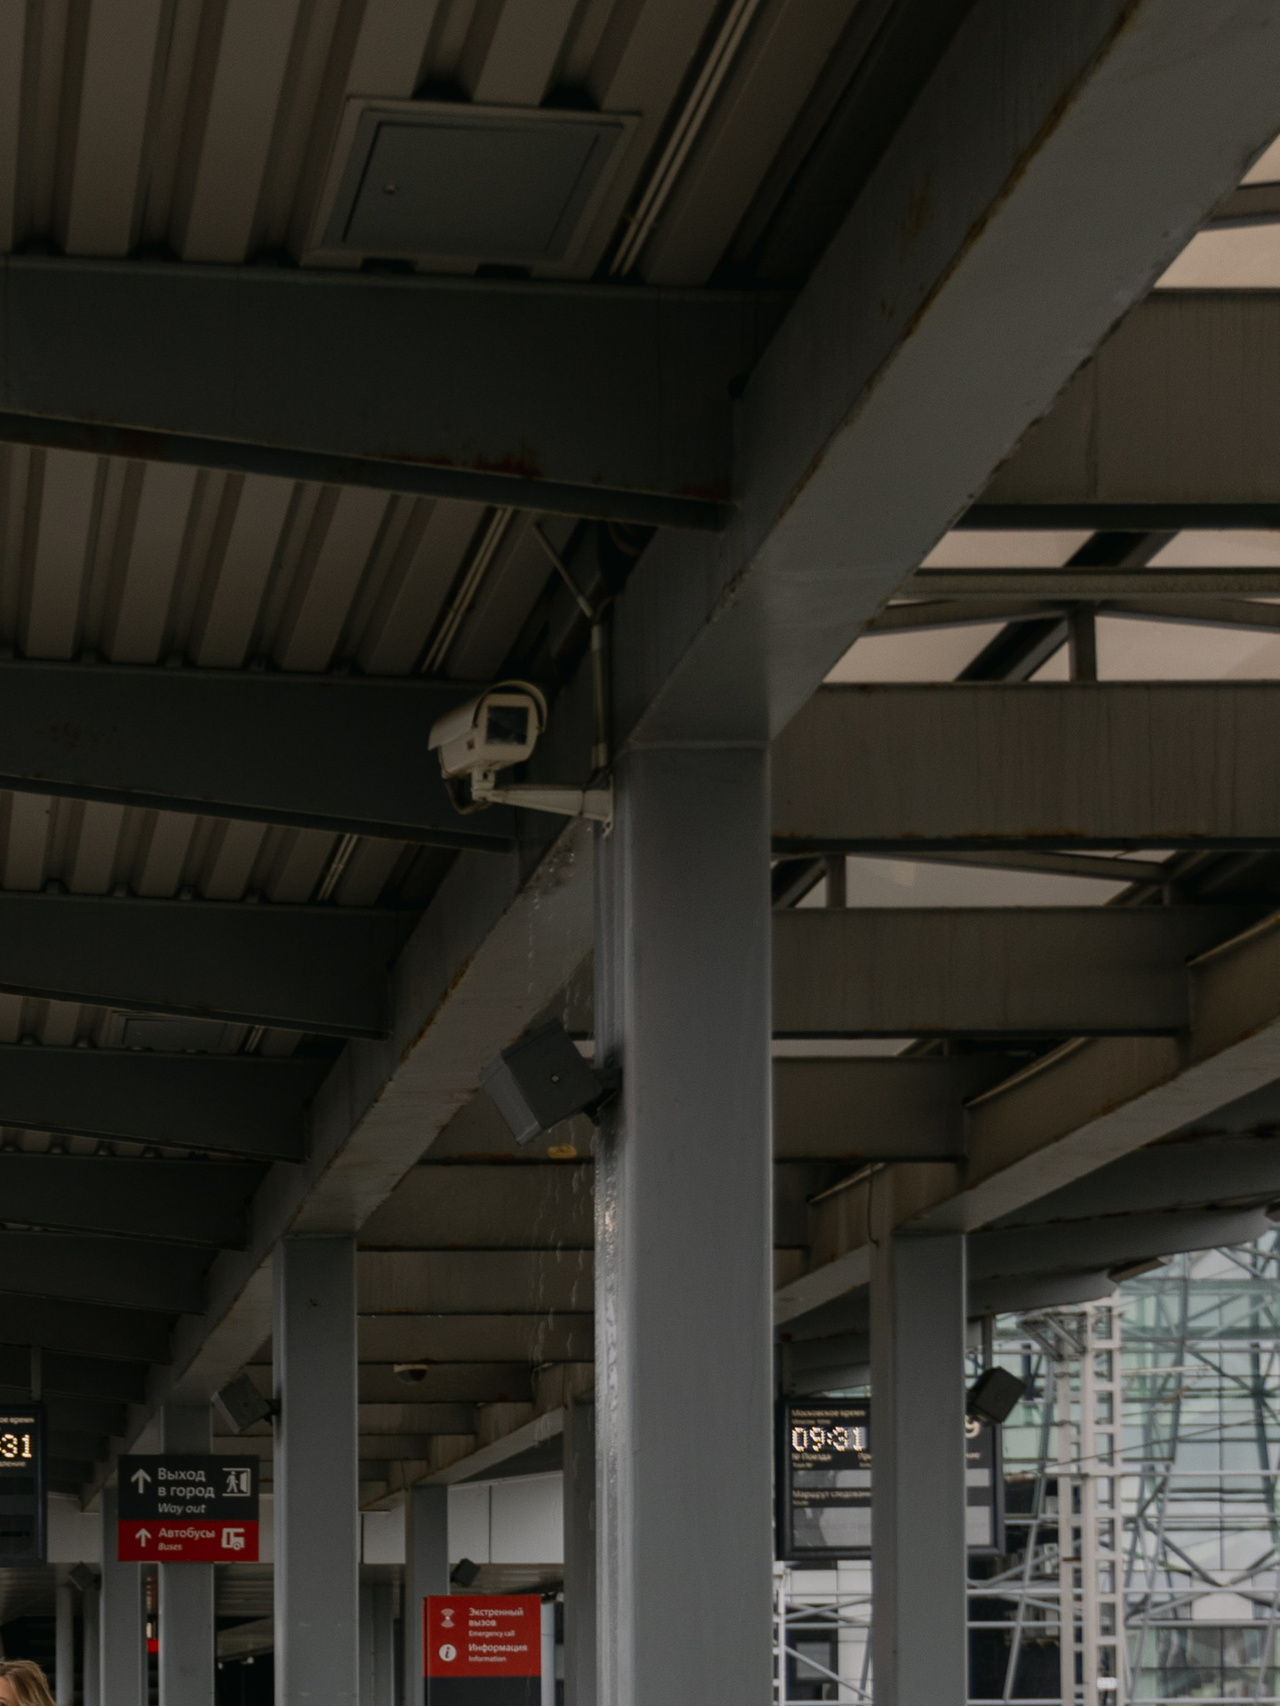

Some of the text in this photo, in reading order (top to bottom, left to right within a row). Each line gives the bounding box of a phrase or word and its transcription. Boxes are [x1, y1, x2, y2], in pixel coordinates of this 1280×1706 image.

[791, 1426, 863, 1453] 09:31
[157, 1467, 207, 1482] Выход
[157, 1486, 216, 1499] в город
[157, 1503, 207, 1515] Way out
[157, 1526, 216, 1540] Автобусы
[157, 1542, 183, 1551] Buses
[468, 1607, 524, 1618] Экстренный
[468, 1618, 497, 1627] вызов
[468, 1629, 503, 1638] Emergency
[468, 1643, 528, 1653] Информация
